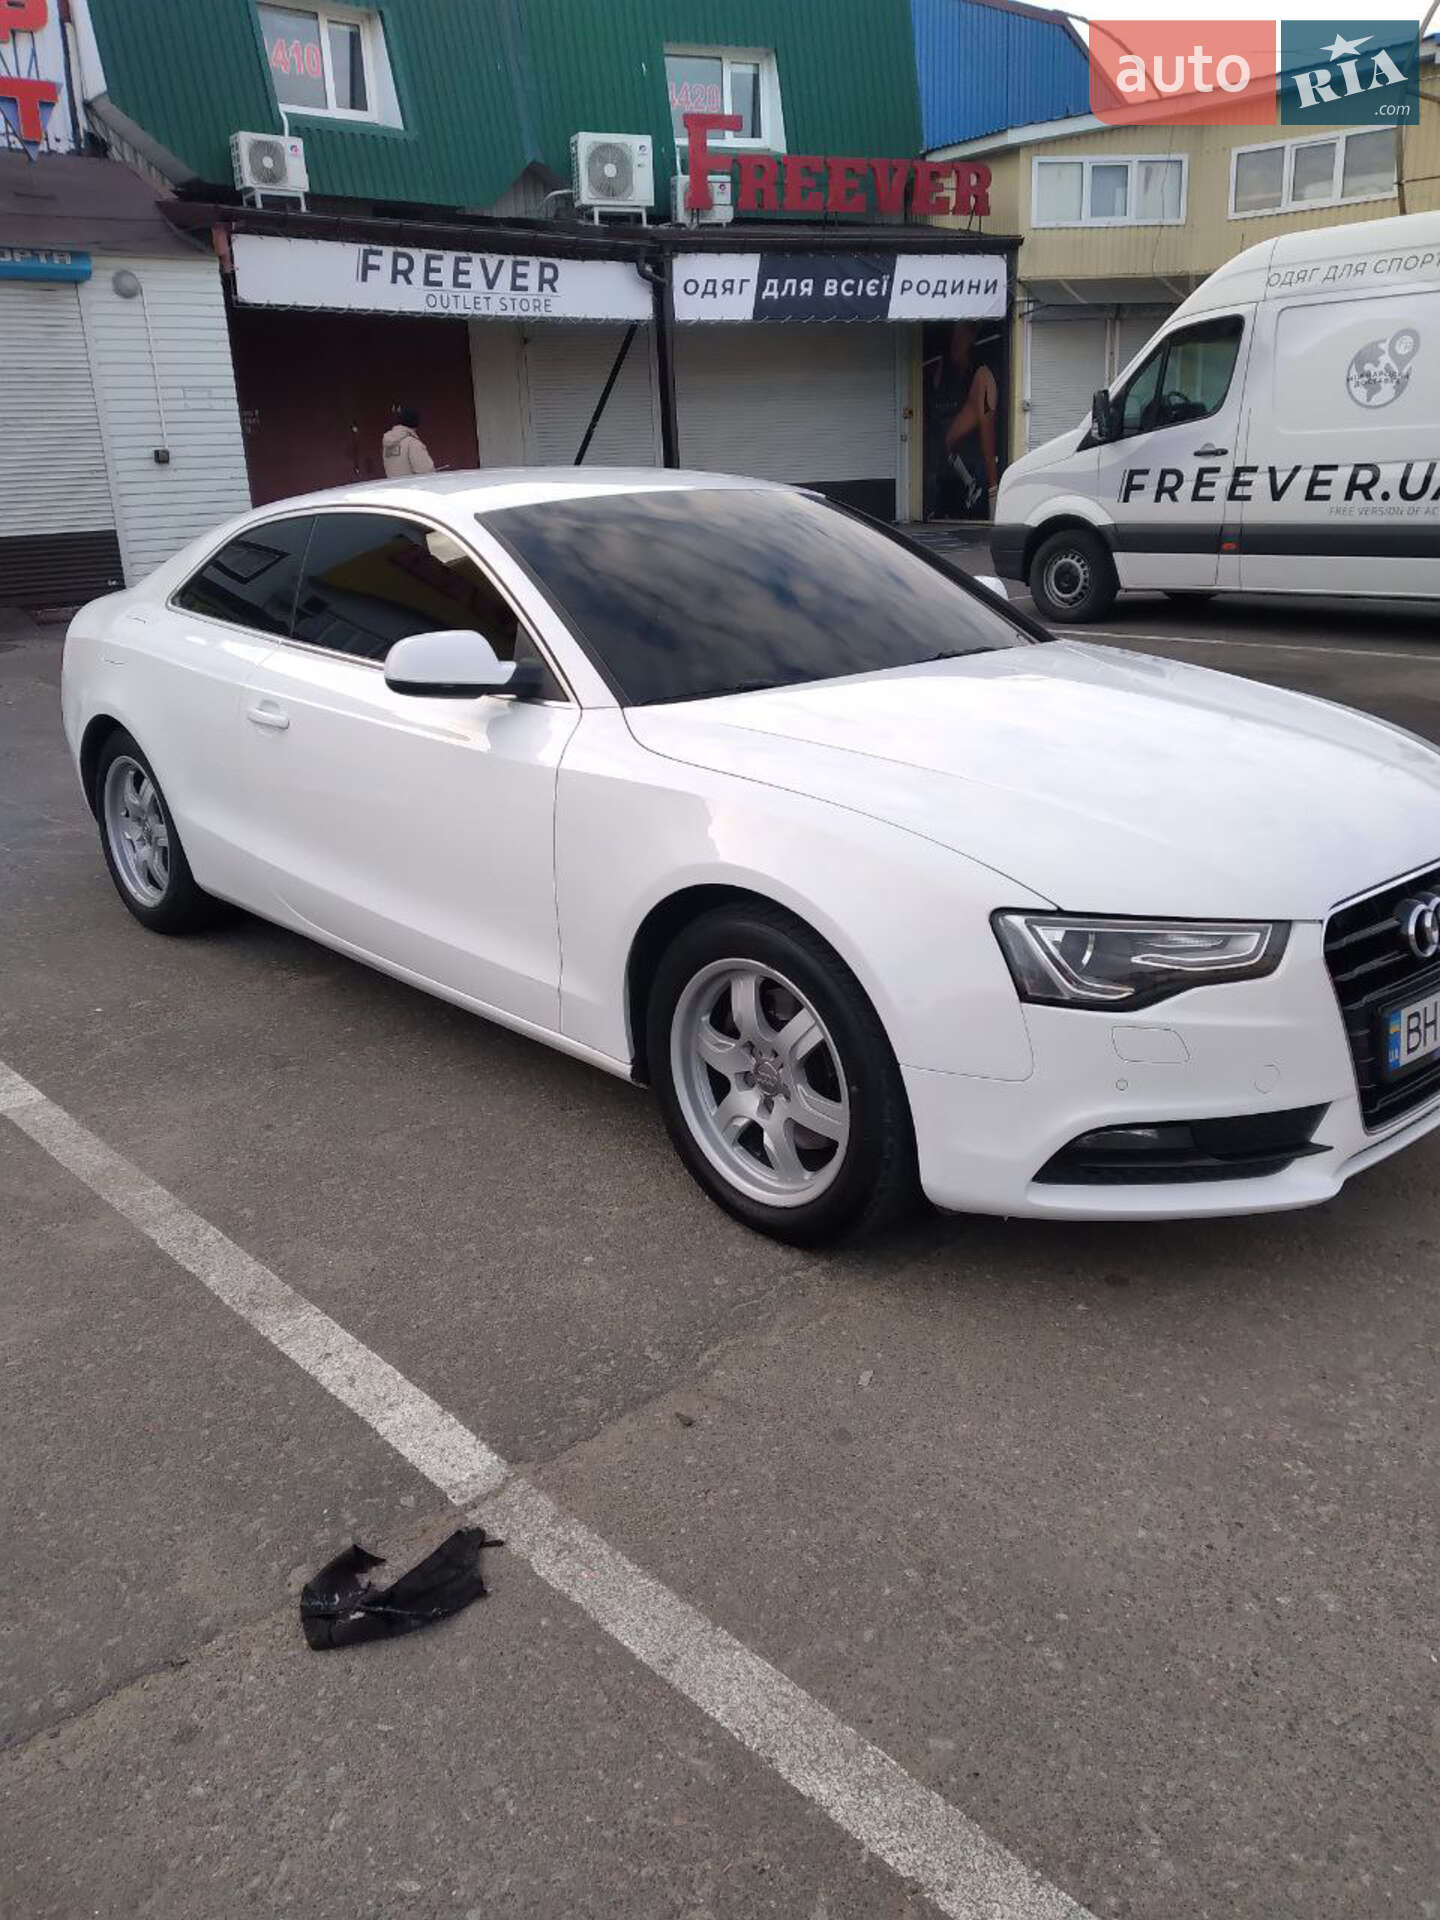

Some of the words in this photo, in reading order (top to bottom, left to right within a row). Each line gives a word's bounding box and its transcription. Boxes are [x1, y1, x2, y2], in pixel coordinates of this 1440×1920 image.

[683, 113, 993, 217] FREEVER
[360, 248, 560, 293] FREEVER
[1267, 267, 1321, 288] ОДЯГ
[1321, 261, 1368, 284] ДЛЯ
[682, 278, 751, 299] ОДЯГ
[761, 278, 814, 300] ДЛЯ
[823, 274, 891, 297] ВСІЄЇ
[899, 278, 999, 299] РОДИНИ
[425, 293, 492, 311] OUTLET
[498, 296, 553, 313] STORE
